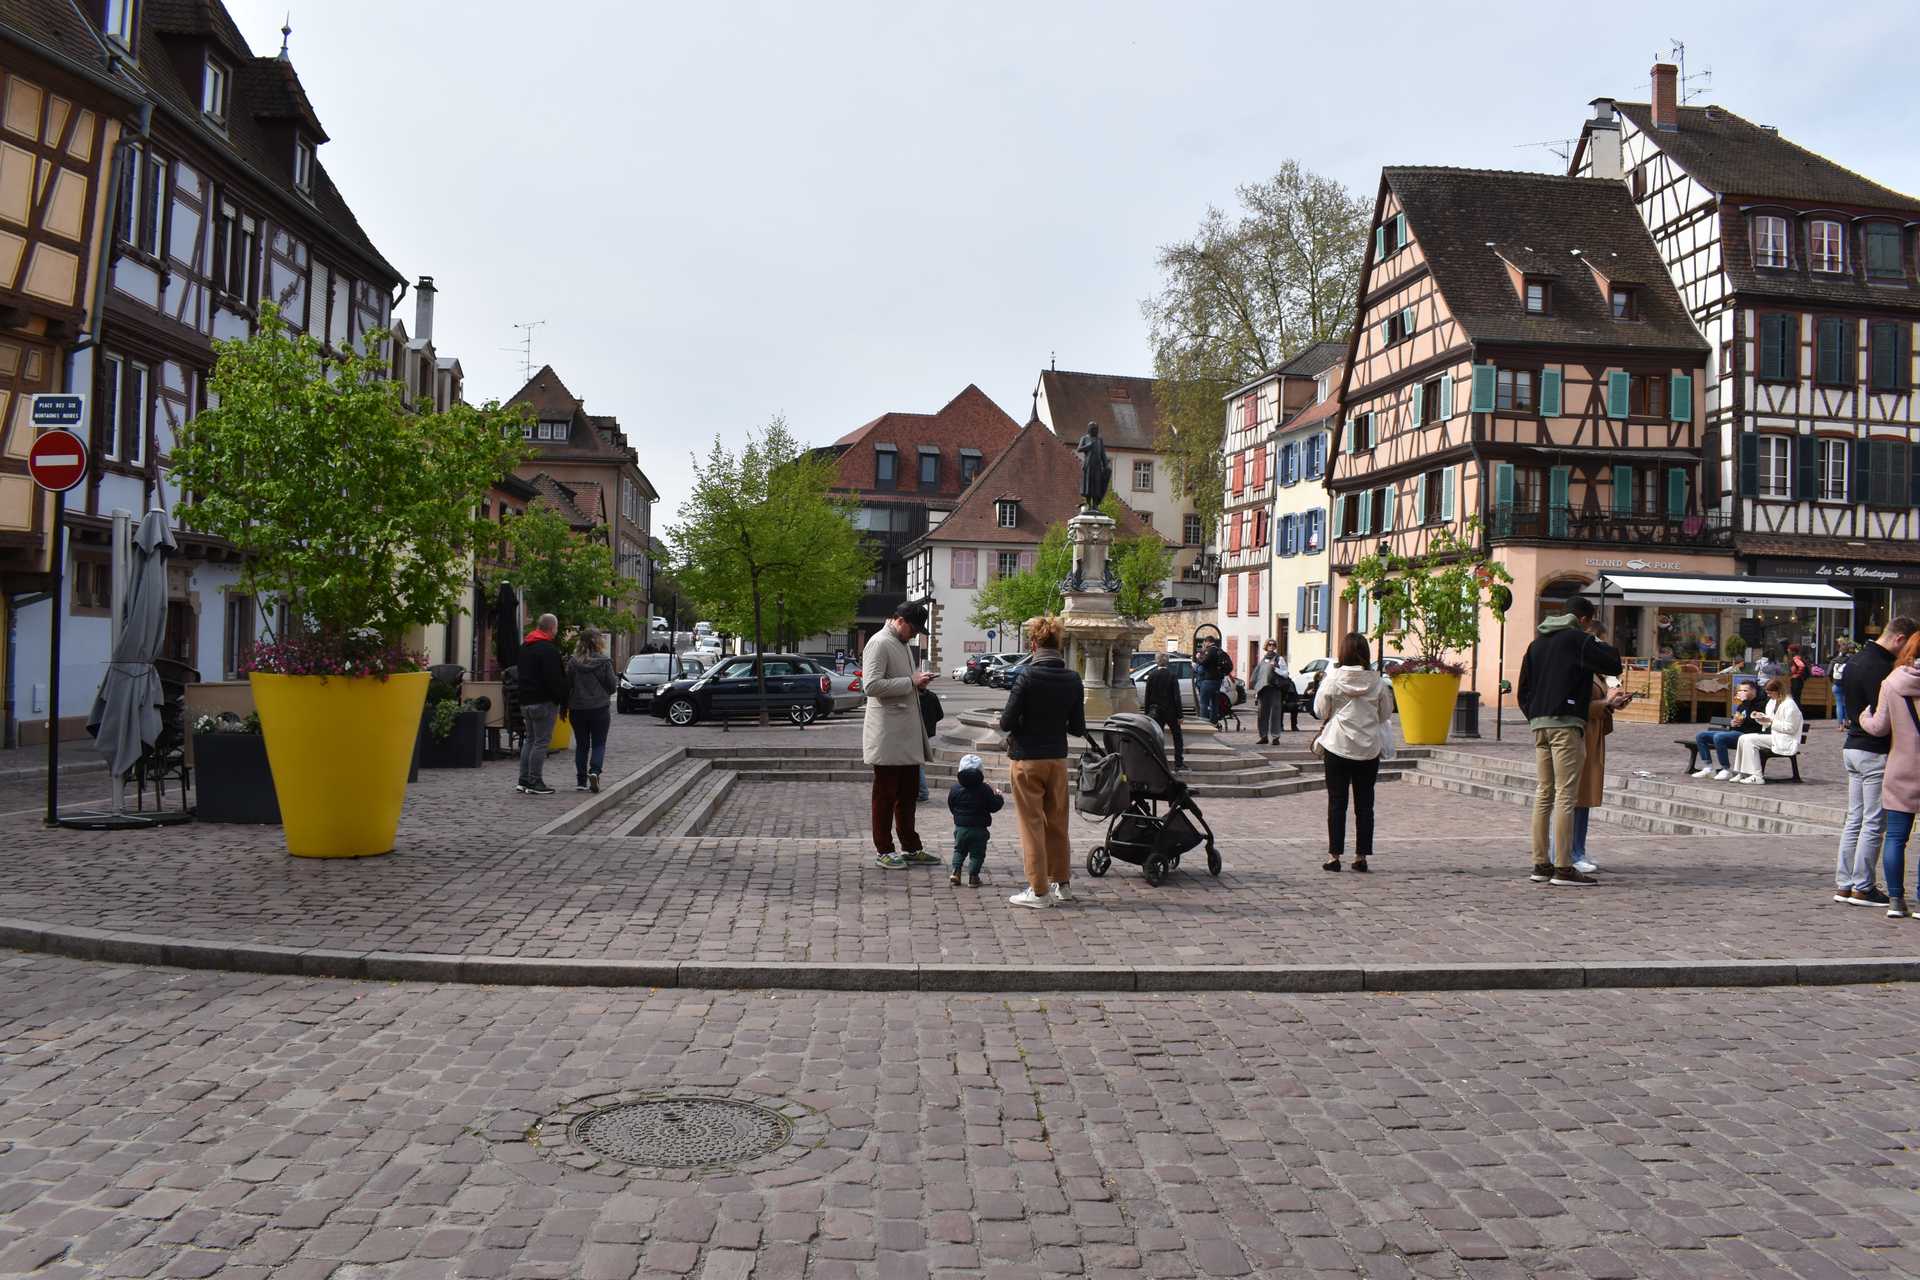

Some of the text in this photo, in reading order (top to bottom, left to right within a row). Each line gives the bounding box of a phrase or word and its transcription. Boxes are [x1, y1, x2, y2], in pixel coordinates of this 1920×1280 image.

[1585, 559, 1623, 568] ISLAND
[1816, 565, 1833, 575] Les
[837, 651, 844, 659] P
